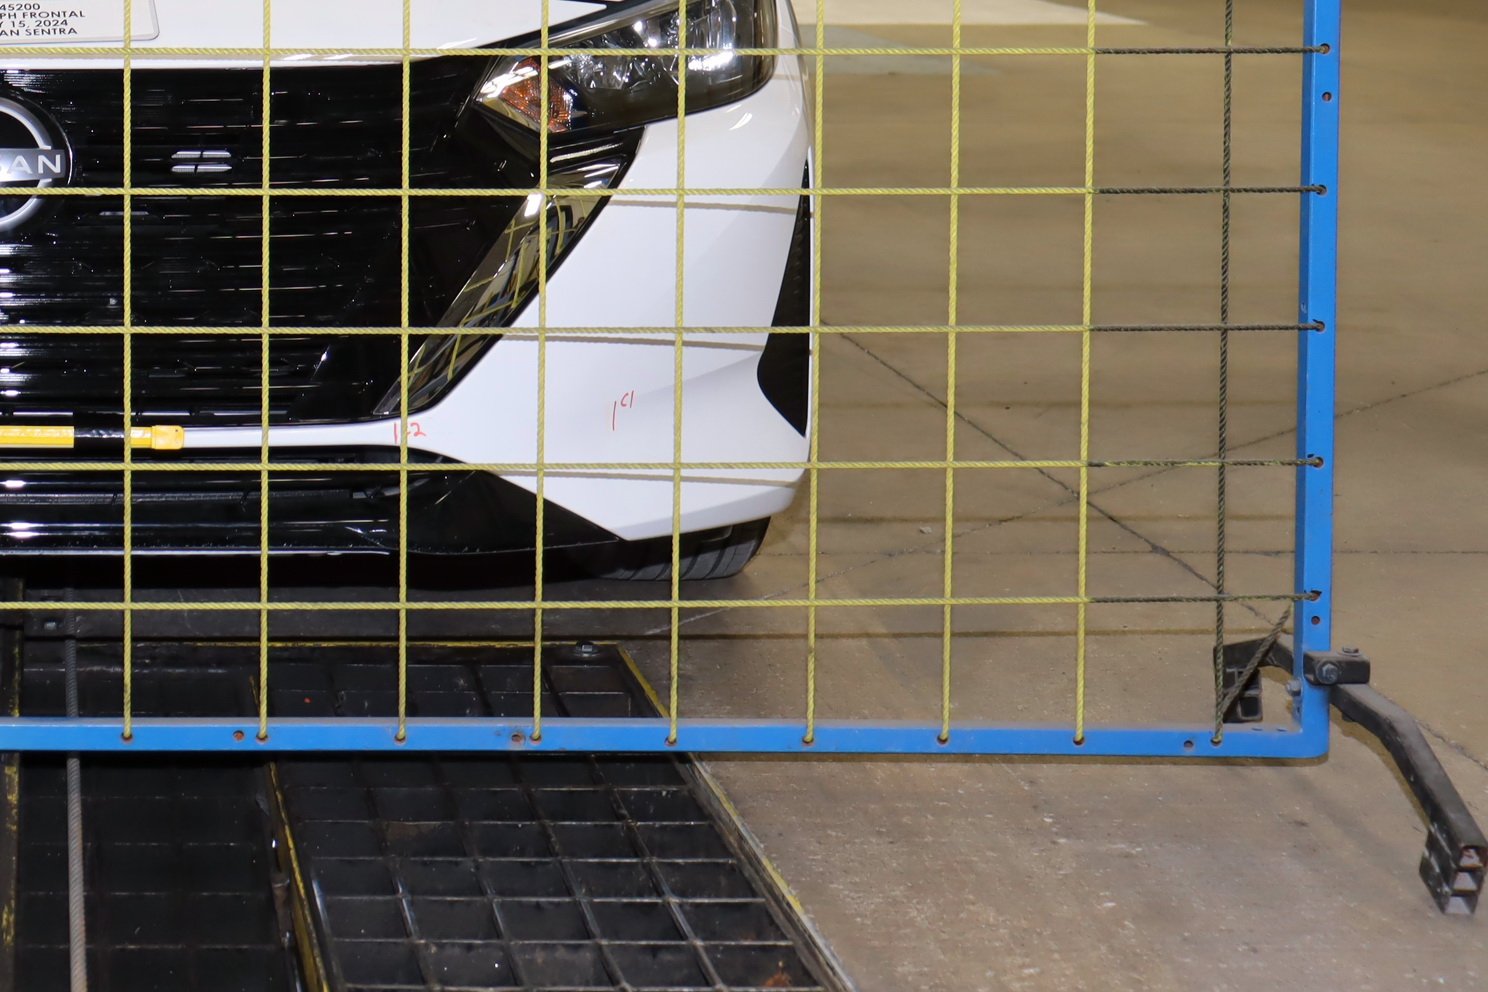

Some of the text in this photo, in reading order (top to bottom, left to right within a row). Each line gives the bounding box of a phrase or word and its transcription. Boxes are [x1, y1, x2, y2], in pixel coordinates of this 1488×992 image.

[22, 10, 86, 19] FRONTAL
[35, 19, 69, 28] 2024
[25, 27, 78, 37] SENTRA
